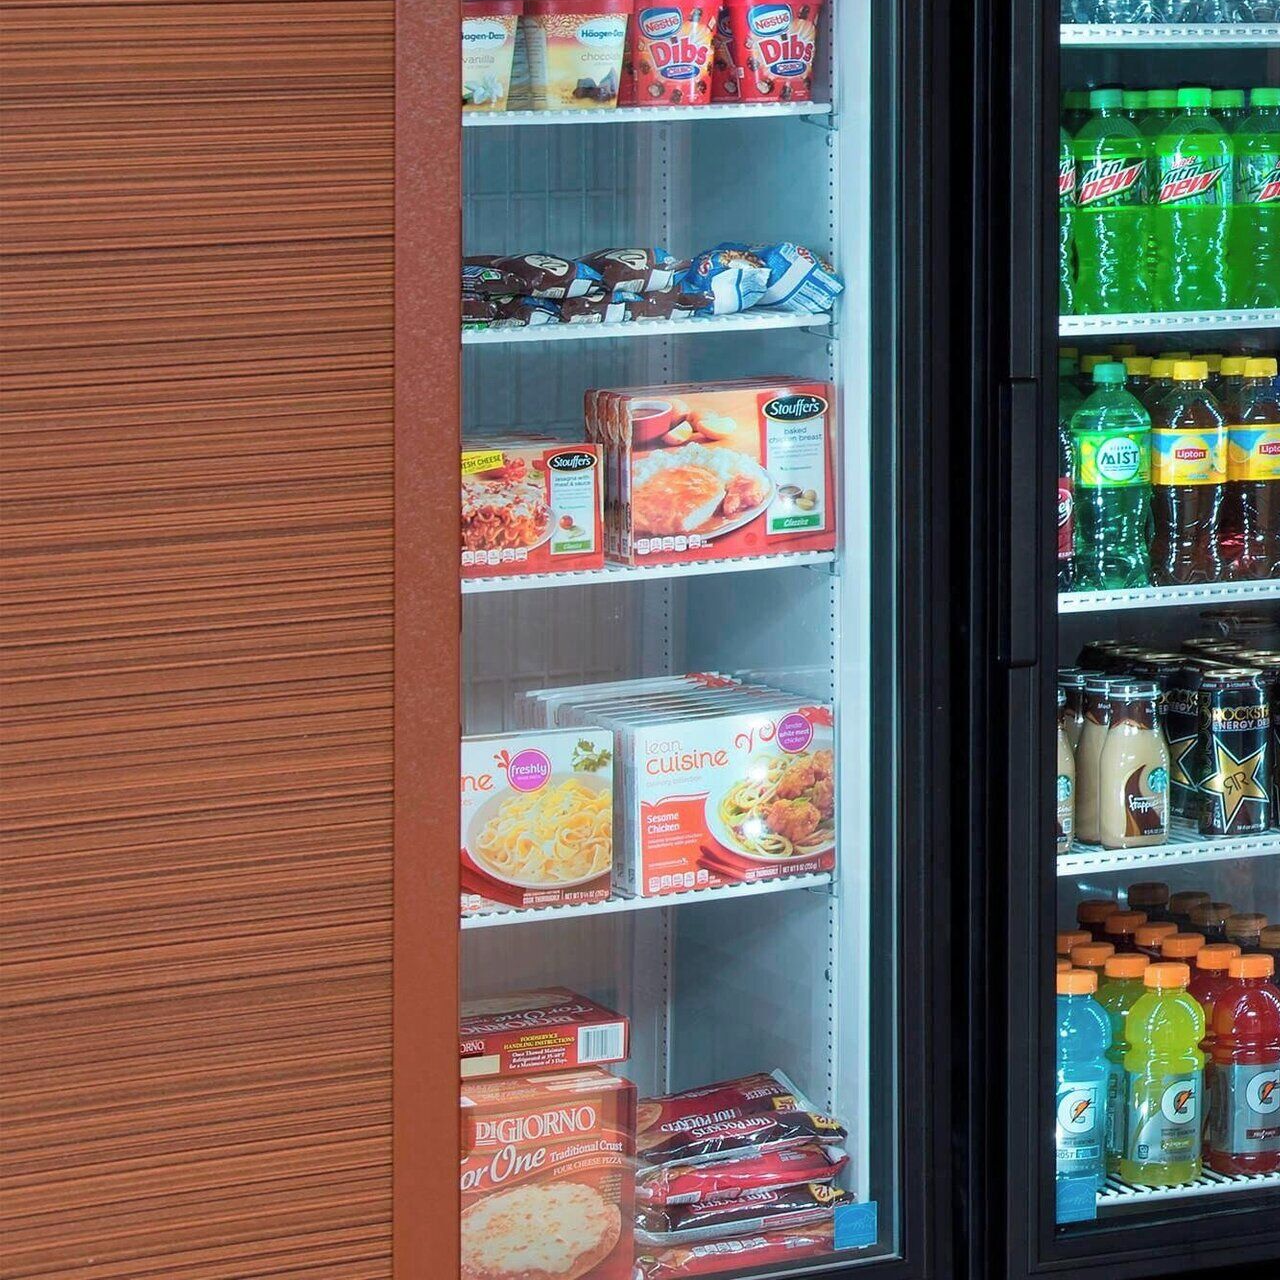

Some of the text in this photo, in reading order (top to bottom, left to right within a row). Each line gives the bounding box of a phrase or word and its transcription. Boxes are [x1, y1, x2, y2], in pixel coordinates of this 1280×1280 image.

[650, 36, 709, 68] Dibs
[758, 34, 814, 66] Dibs
[769, 397, 821, 417] Stouffer's
[783, 426, 808, 435] baked
[477, 454, 501, 467] CHEESE
[553, 455, 592, 469] Stouffer's
[1176, 449, 1205, 460] Lipton
[1212, 719, 1255, 732] ENERGY
[645, 739, 682, 755] lean
[646, 748, 729, 776] cuisine
[511, 763, 547, 778] freshly
[647, 811, 680, 824] Sesame
[647, 823, 680, 835] Chicken
[504, 1036, 575, 1050] HANDLING INSTRUCTIONS
[1246, 1070, 1280, 1114] G
[1161, 1080, 1196, 1124] G
[1057, 1089, 1098, 1133] G
[490, 1140, 623, 1183] One Traditional Crust
[553, 1156, 622, 1176] FOUR CHEESE PIZZA
